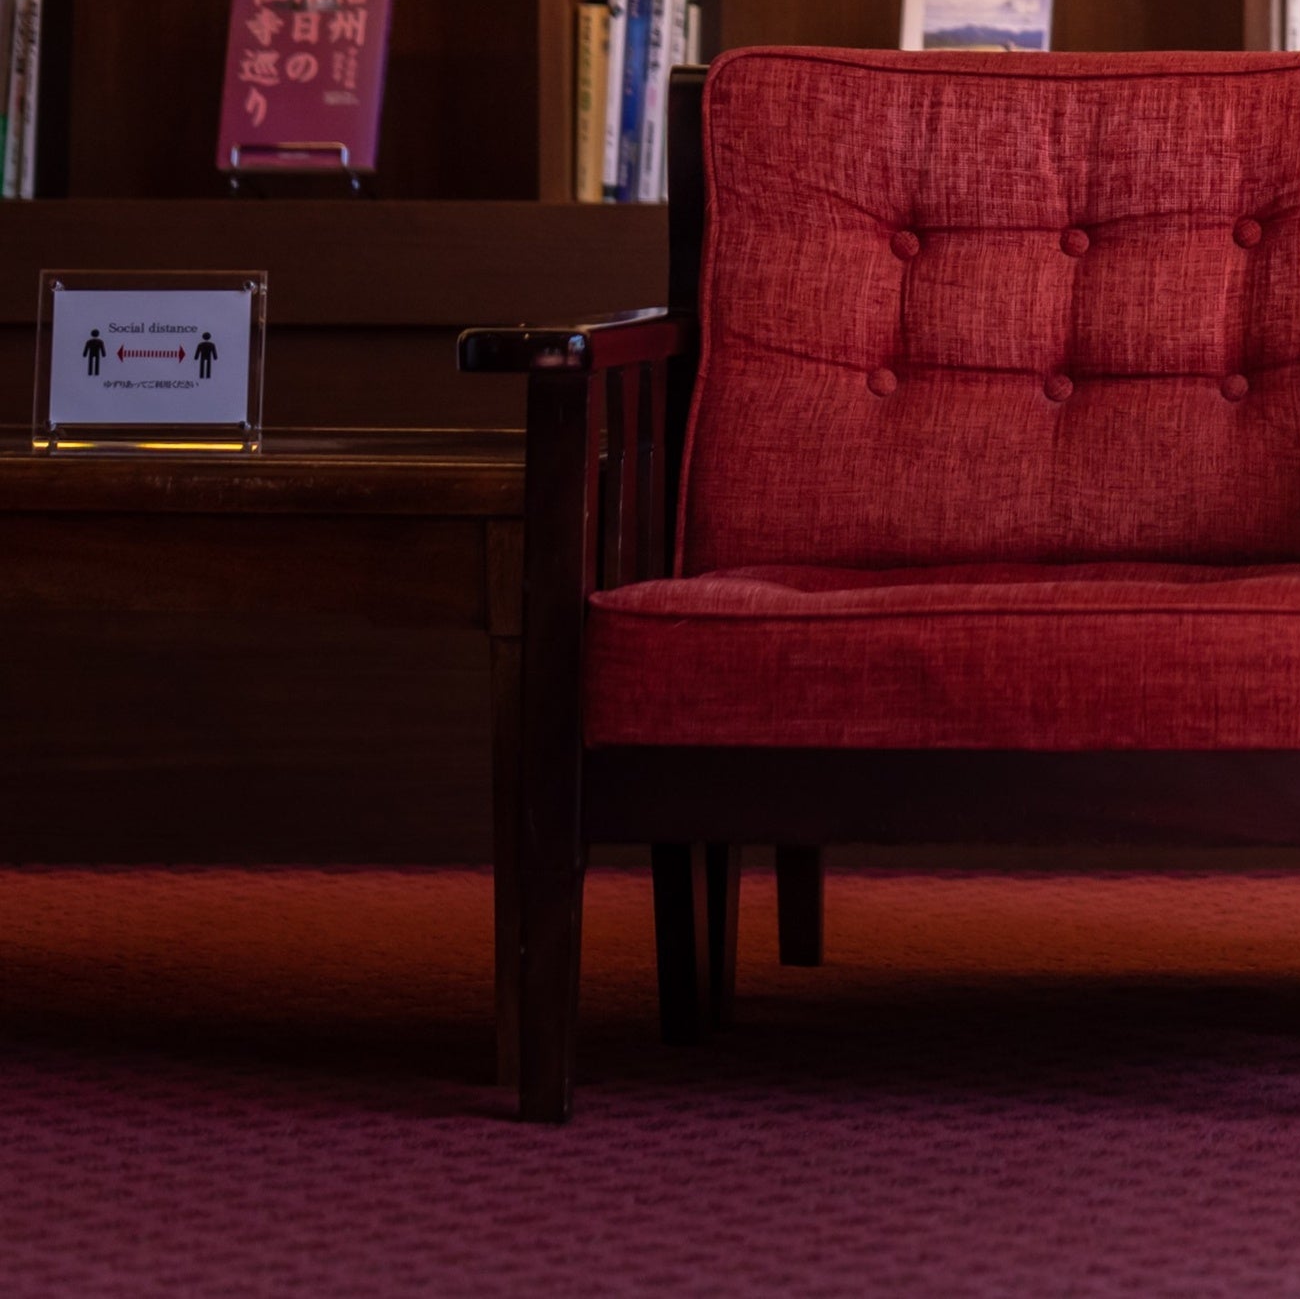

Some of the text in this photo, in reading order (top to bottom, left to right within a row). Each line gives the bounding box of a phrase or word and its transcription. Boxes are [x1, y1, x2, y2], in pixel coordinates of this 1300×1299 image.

[108, 322, 199, 334] Social distance
[103, 380, 200, 389] ゆずりあってご利用ください
